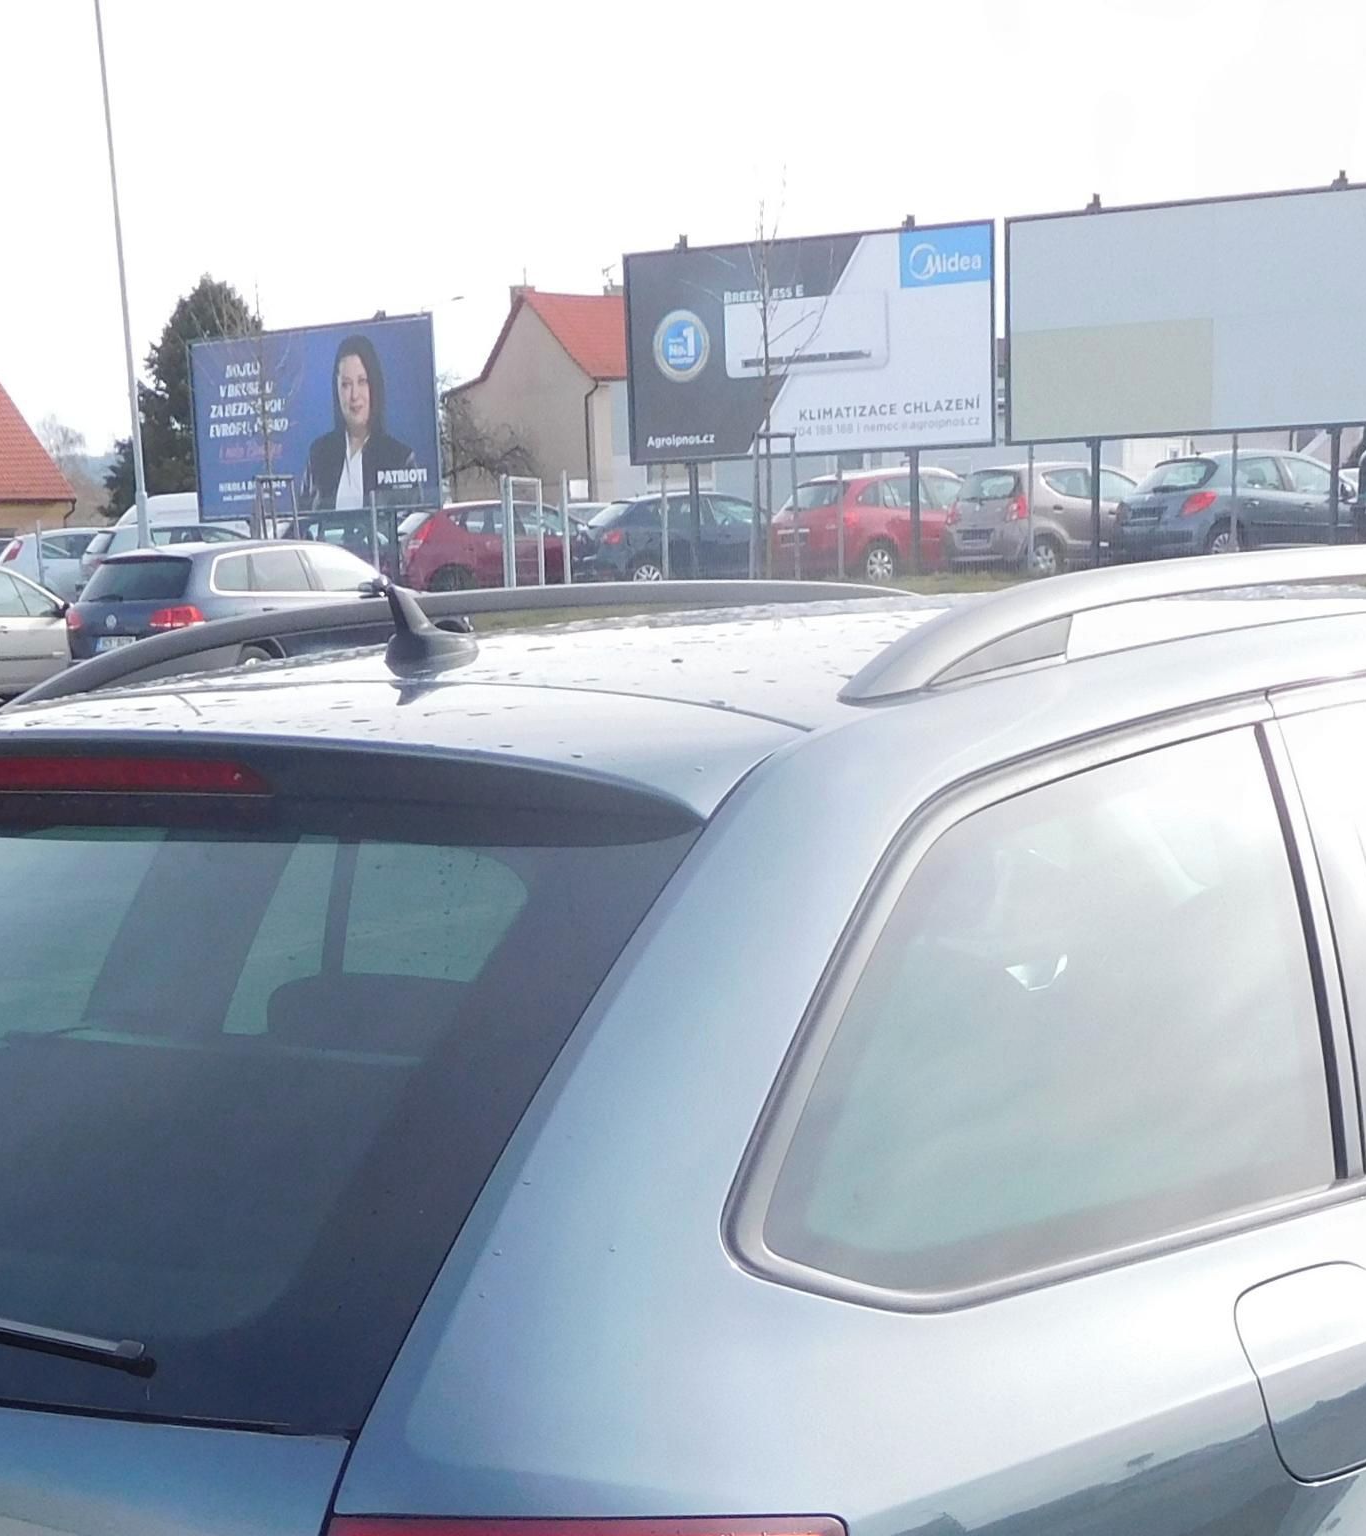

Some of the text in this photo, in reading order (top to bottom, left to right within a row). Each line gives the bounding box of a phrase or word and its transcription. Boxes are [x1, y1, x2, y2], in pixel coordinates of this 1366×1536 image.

[922, 251, 982, 274] Midea
[799, 394, 981, 422] KLIMATIZACE CHLAZENÍ
[377, 468, 427, 485] PATRIOTI
